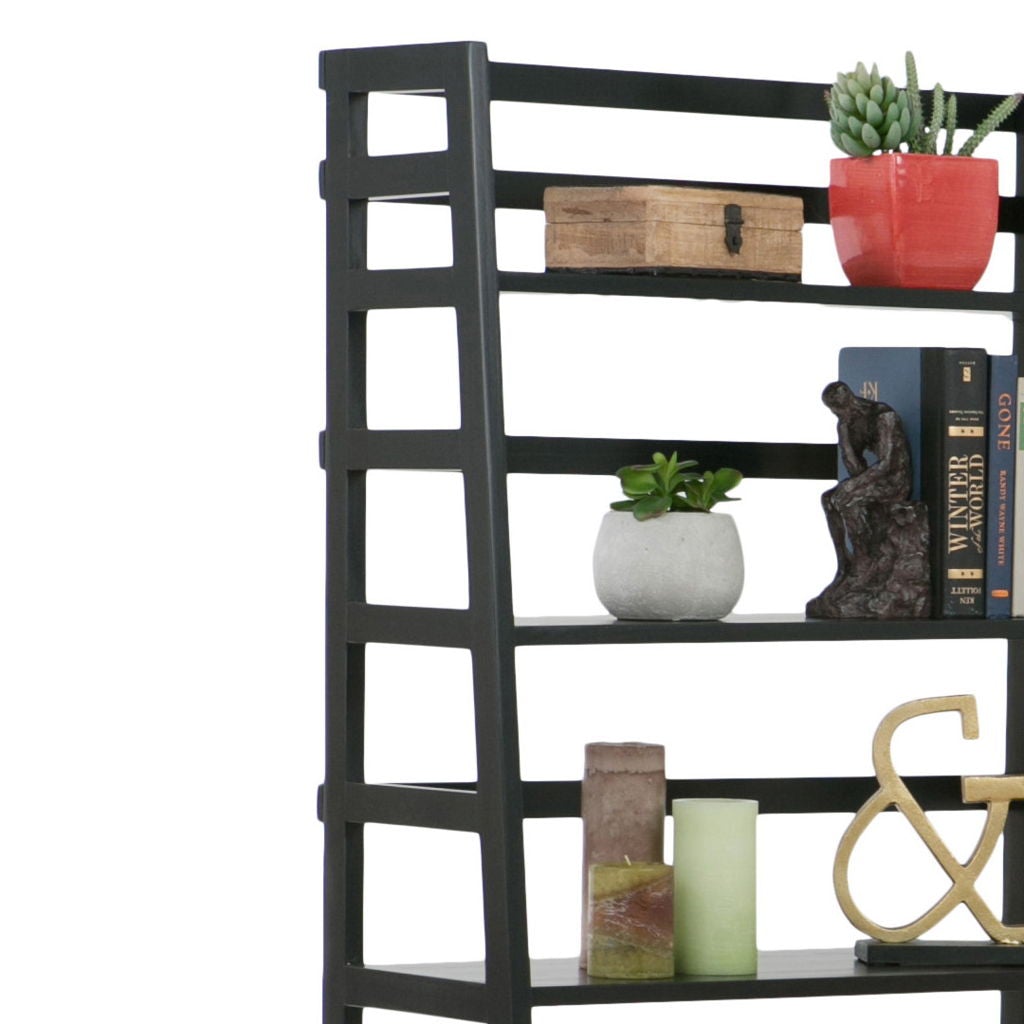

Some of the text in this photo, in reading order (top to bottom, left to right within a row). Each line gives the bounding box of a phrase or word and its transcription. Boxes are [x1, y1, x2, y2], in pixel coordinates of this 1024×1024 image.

[997, 393, 1012, 450] GONE
[947, 454, 969, 554] WINTER
[968, 453, 984, 529] WORLD
[997, 469, 1008, 566] RANDY WAYNE WHITE
[950, 586, 982, 595] FOLLETT
[960, 597, 975, 605] KEN
